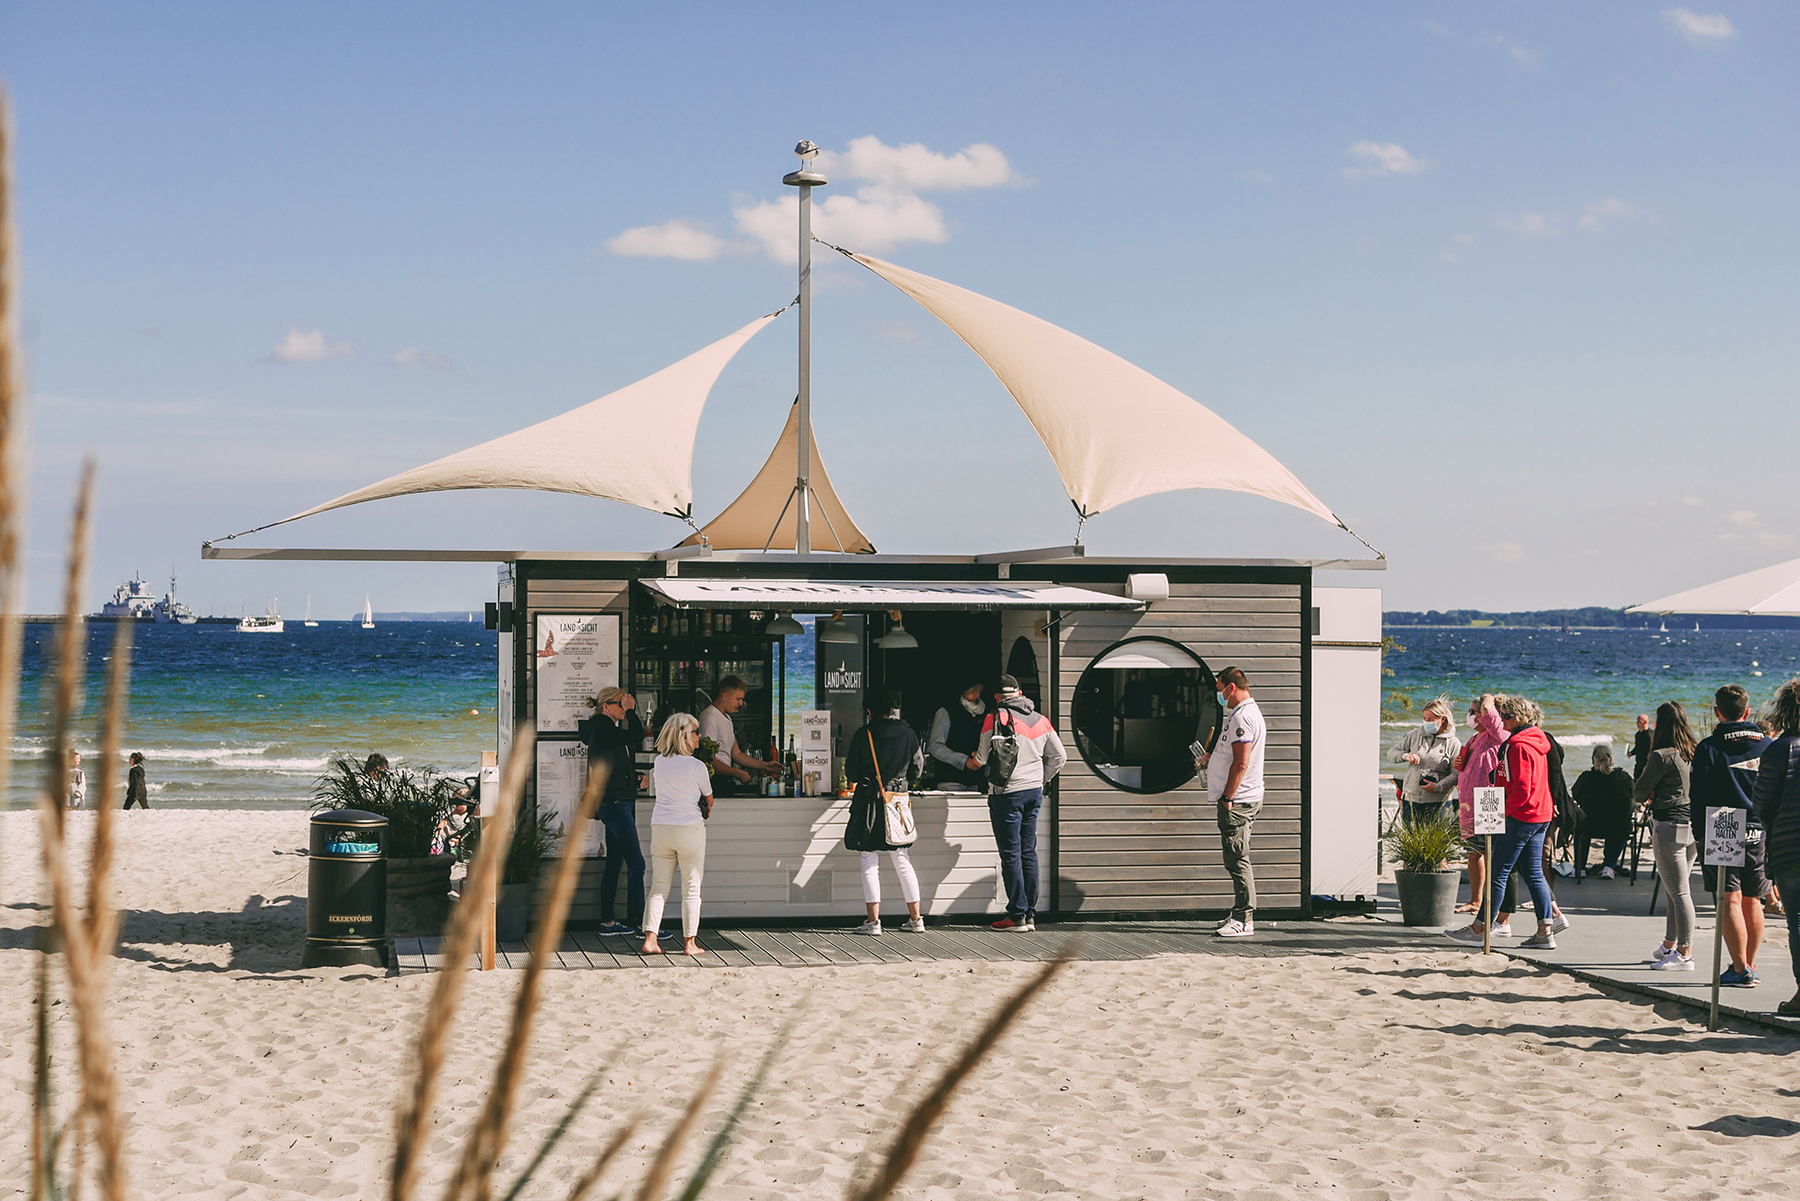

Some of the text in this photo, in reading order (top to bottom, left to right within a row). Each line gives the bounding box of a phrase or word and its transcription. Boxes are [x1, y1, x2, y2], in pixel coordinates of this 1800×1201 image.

[560, 623, 576, 632] LAND
[581, 623, 598, 632] SICHT
[824, 671, 840, 688] LAND
[845, 671, 862, 688] SICHT
[560, 748, 576, 757] LAND
[1480, 797, 1500, 806] ABSTAND
[1481, 804, 1499, 812] HALTEN
[1718, 811, 1735, 822] BITTE
[1713, 820, 1740, 831] ABSTAND
[1715, 829, 1737, 839] HALTEN
